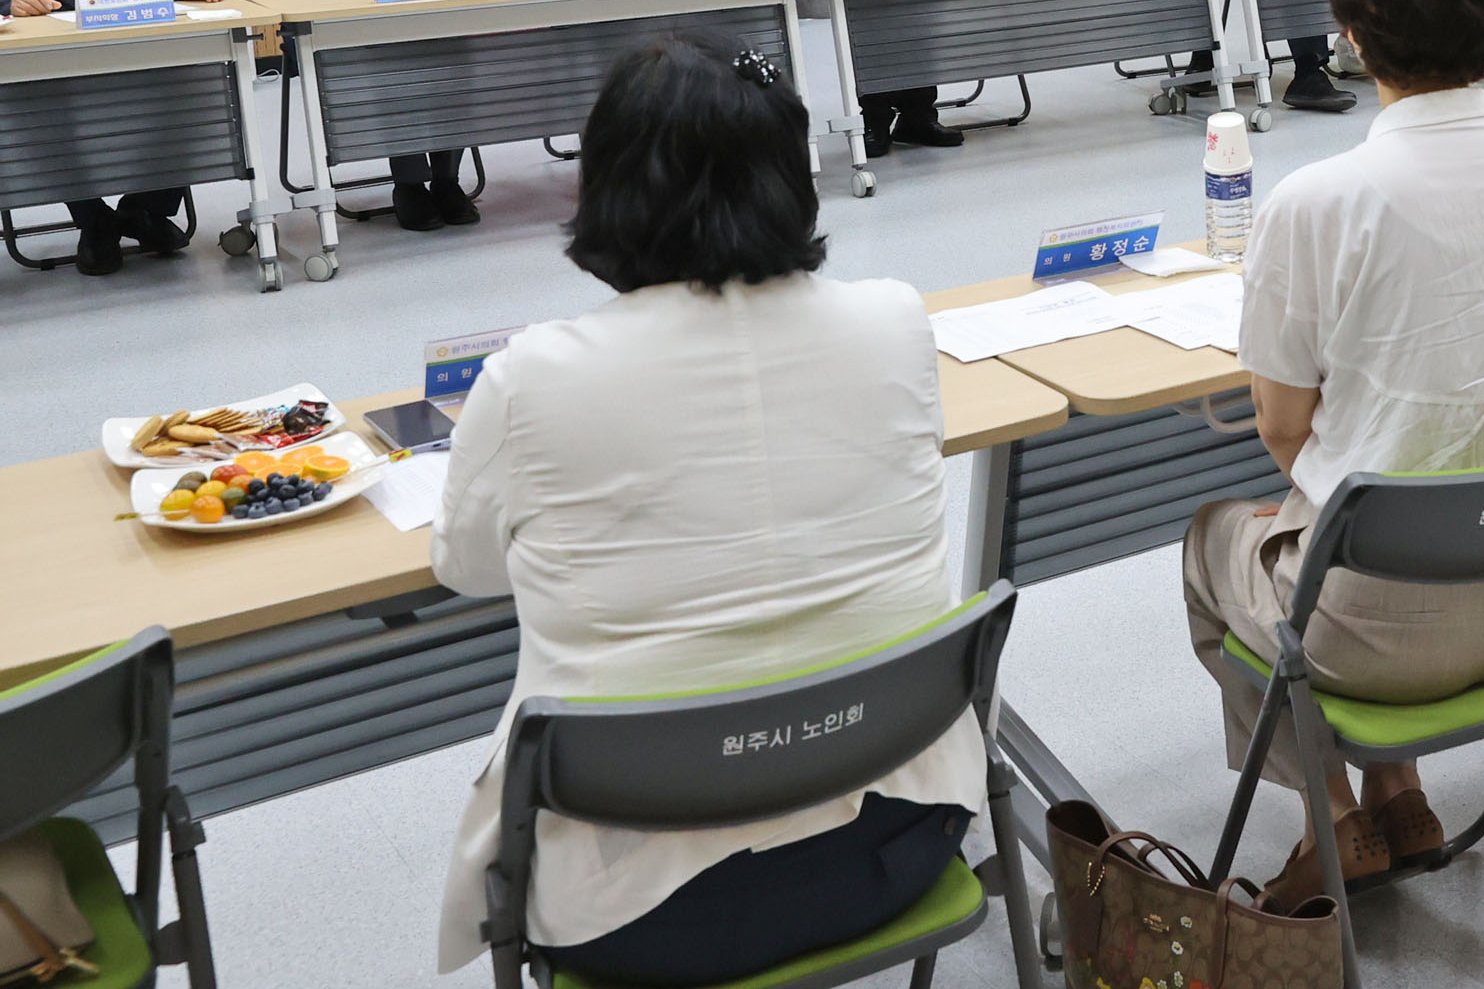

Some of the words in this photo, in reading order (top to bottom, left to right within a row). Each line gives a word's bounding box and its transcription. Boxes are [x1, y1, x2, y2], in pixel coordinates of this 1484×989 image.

[124, 6, 170, 21] 김범수
[1088, 235, 1150, 262] 황정순
[436, 367, 472, 383] 의원
[722, 725, 792, 756] 원주시
[801, 702, 865, 741] 노인회
